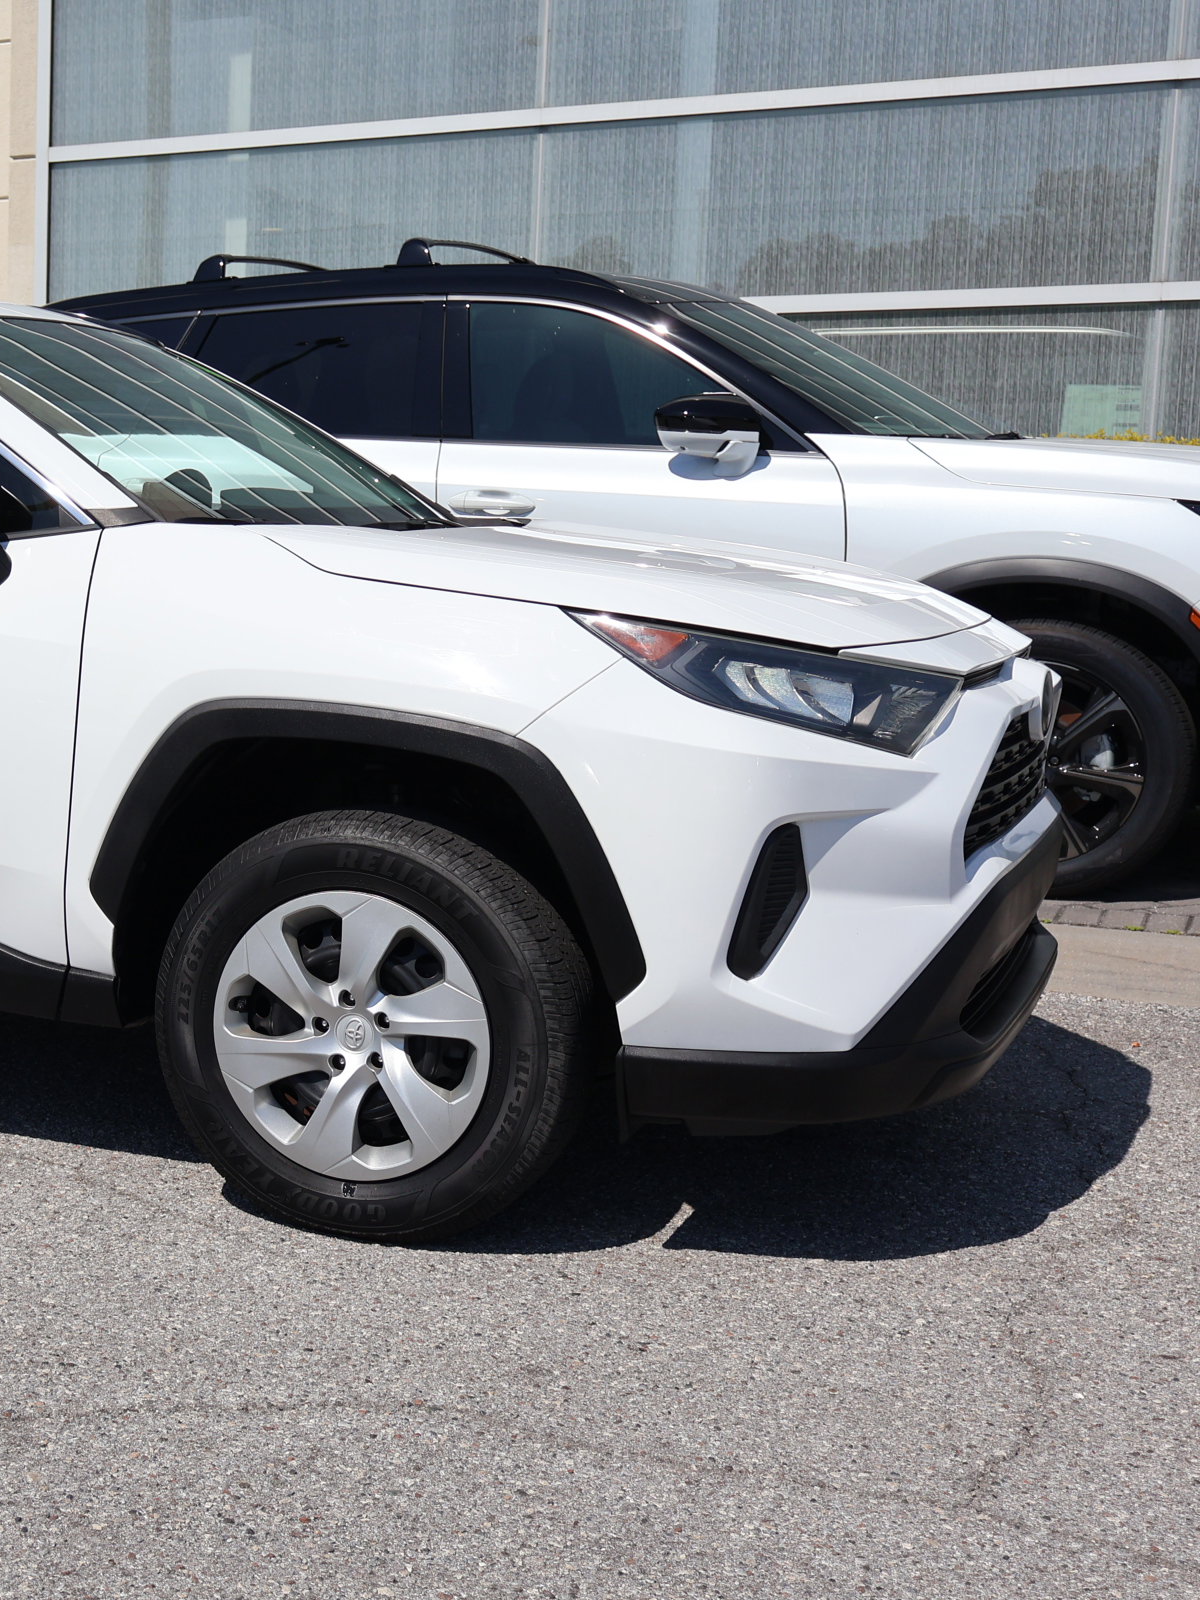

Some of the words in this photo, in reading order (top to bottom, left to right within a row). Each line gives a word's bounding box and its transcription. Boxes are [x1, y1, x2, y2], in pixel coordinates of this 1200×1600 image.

[336, 847, 481, 921] RELIANT
[176, 906, 225, 1025] 225/65R17
[471, 1048, 531, 1174] ALL-SEASON
